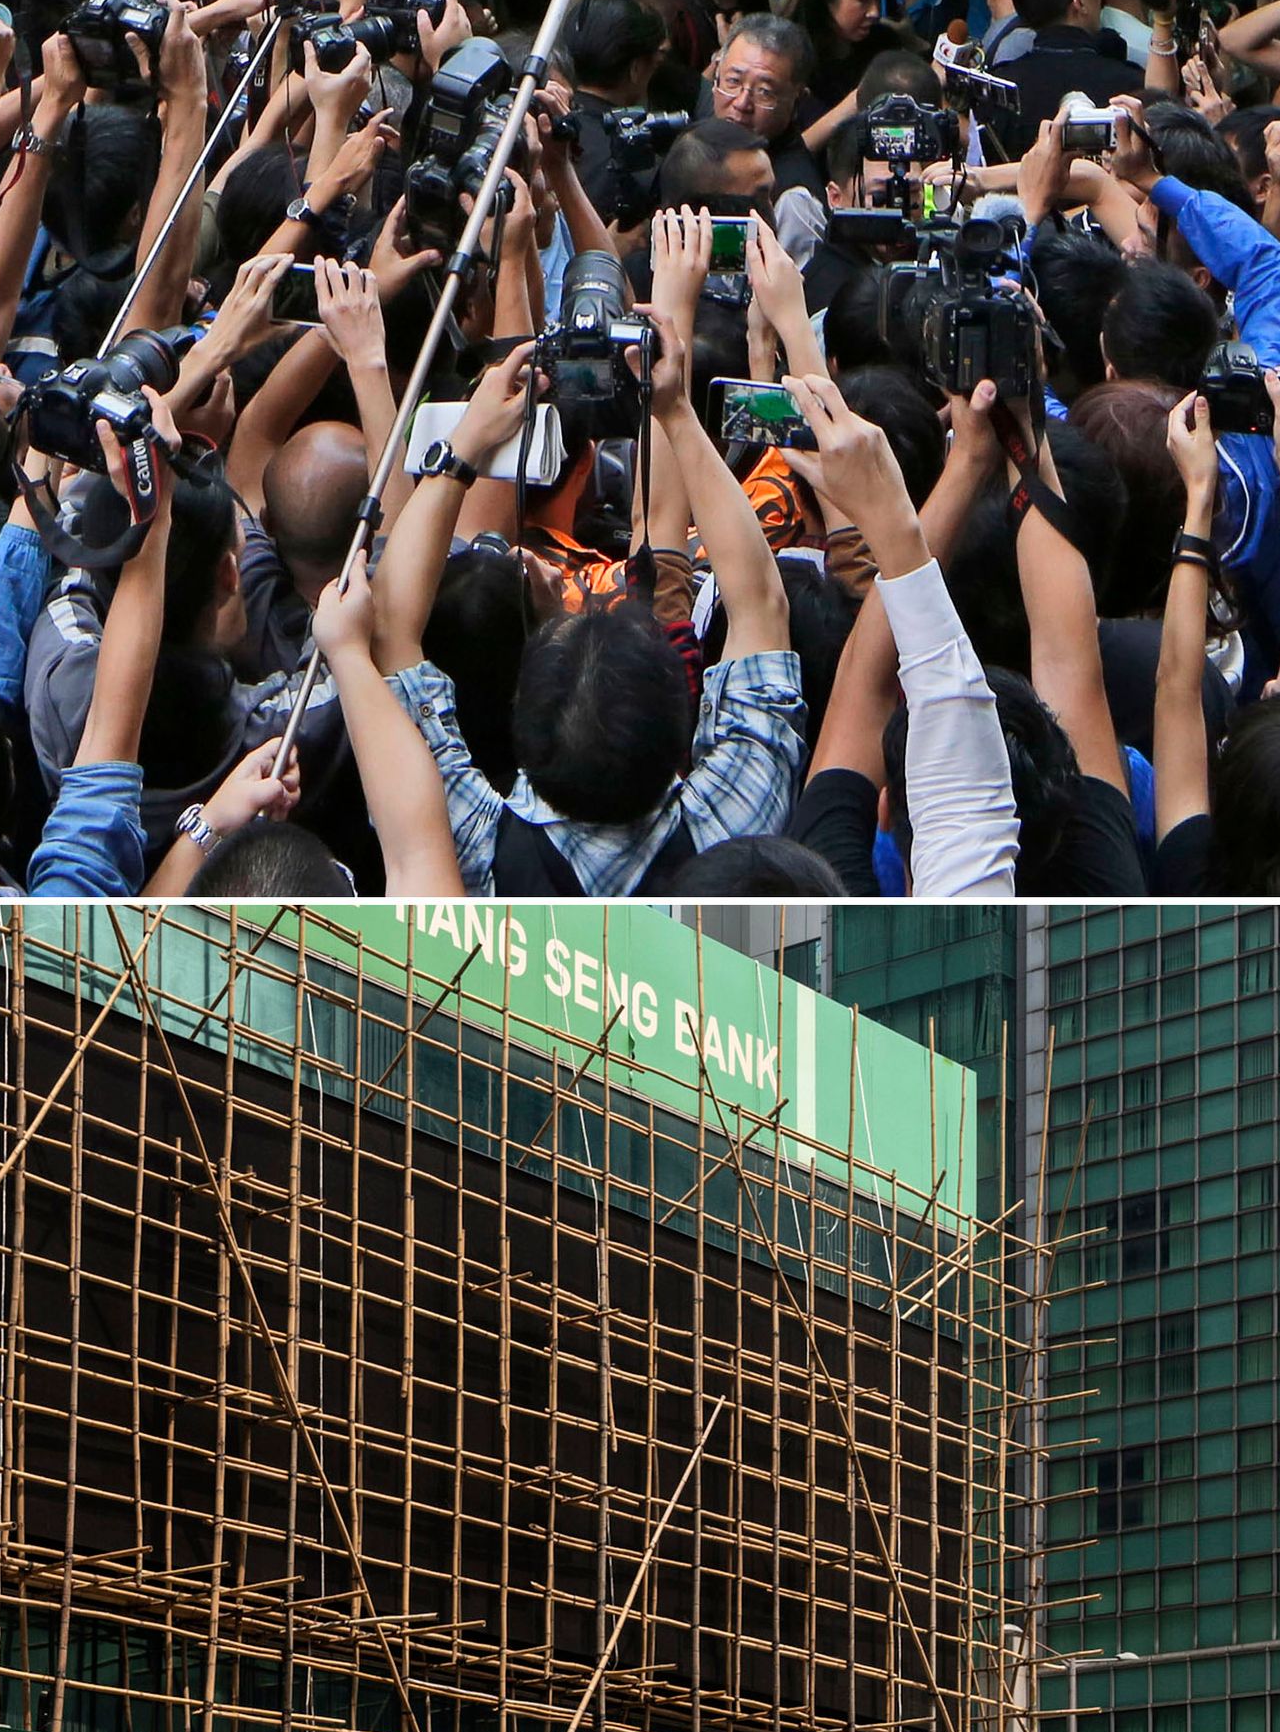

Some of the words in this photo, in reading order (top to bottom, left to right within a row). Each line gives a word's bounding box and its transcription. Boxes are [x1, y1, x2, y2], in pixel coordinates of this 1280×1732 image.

[131, 437, 154, 497] Canon
[543, 938, 659, 1038] SENG
[674, 999, 779, 1096] BANK
